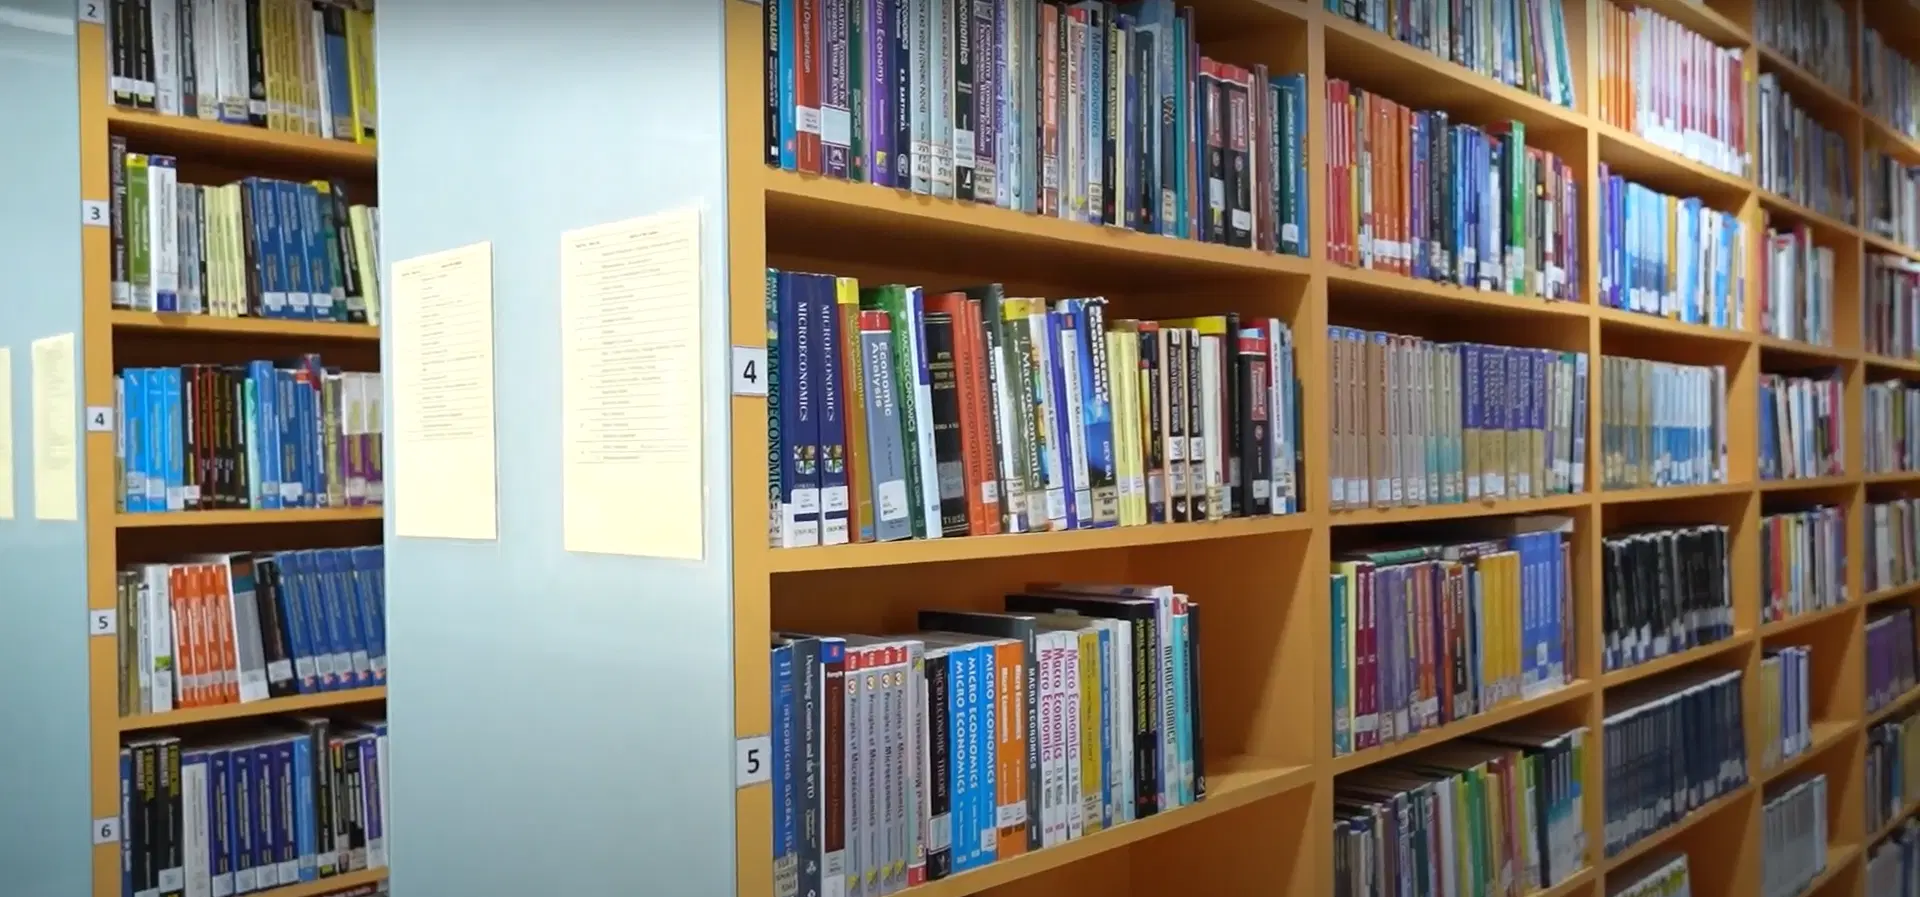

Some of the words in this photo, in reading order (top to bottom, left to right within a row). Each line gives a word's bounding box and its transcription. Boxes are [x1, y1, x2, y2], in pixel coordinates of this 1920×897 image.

[87, 6, 96, 17] 2
[803, 11, 812, 74] Organization
[875, 28, 886, 84] Economy
[1091, 33, 1101, 139] Macroeconomics
[91, 208, 101, 221] 3
[743, 360, 757, 384] 4
[798, 302, 808, 422] MICROECONOMICS
[822, 304, 836, 422] MICROECONOMICS
[871, 342, 884, 408] Analysis
[987, 331, 997, 379] Marketing
[1089, 306, 1103, 418] Economics
[1095, 306, 1109, 402] Monetary
[880, 342, 893, 417] Economic
[900, 330, 916, 433] MACROECONOMICS
[95, 412, 105, 426] 4
[767, 345, 782, 510] MACROECONOMICS
[962, 352, 981, 488] macroeconomics
[978, 356, 995, 481] macroeconomic
[991, 383, 1002, 445] Management
[1023, 351, 1040, 489] Macroeconomics
[98, 616, 108, 629] 5
[805, 655, 815, 699] Developing
[956, 660, 966, 708] MICRO
[968, 657, 977, 703] MICRO
[986, 654, 995, 699] MICRO
[1014, 664, 1022, 691] Micro
[1029, 668, 1037, 704] MACRO
[1042, 649, 1053, 691] Macro
[1053, 647, 1065, 689] Macro
[1067, 649, 1078, 690] Macro
[851, 698, 859, 738] Principles
[868, 694, 876, 735] Principles
[883, 691, 892, 733] Principles
[896, 689, 904, 731] Principles
[1014, 692, 1022, 741] Economics
[1164, 645, 1175, 745] MICROECONOMICS
[805, 702, 815, 745] Countries
[851, 740, 859, 750] of
[868, 737, 876, 747] of
[883, 735, 892, 745] of
[896, 732, 904, 741] of
[986, 703, 995, 785] ECONOMICS
[1029, 708, 1037, 770] ECONOMICS
[1042, 693, 1053, 764] Economics
[1053, 691, 1065, 760] Economics
[1067, 692, 1078, 761] Economics
[747, 749, 760, 774] 5
[805, 747, 815, 762] and
[805, 763, 815, 775] the
[956, 711, 966, 795] ECONOMICS
[968, 707, 977, 789] ECONOMICS
[805, 775, 815, 799] WTO
[851, 752, 859, 832] Microeconomics
[868, 748, 876, 827] Microeconomics
[883, 746, 892, 824] Microeconomics
[896, 743, 904, 819] Microeconomics
[935, 758, 946, 797] THEORY
[101, 824, 111, 837] 6
